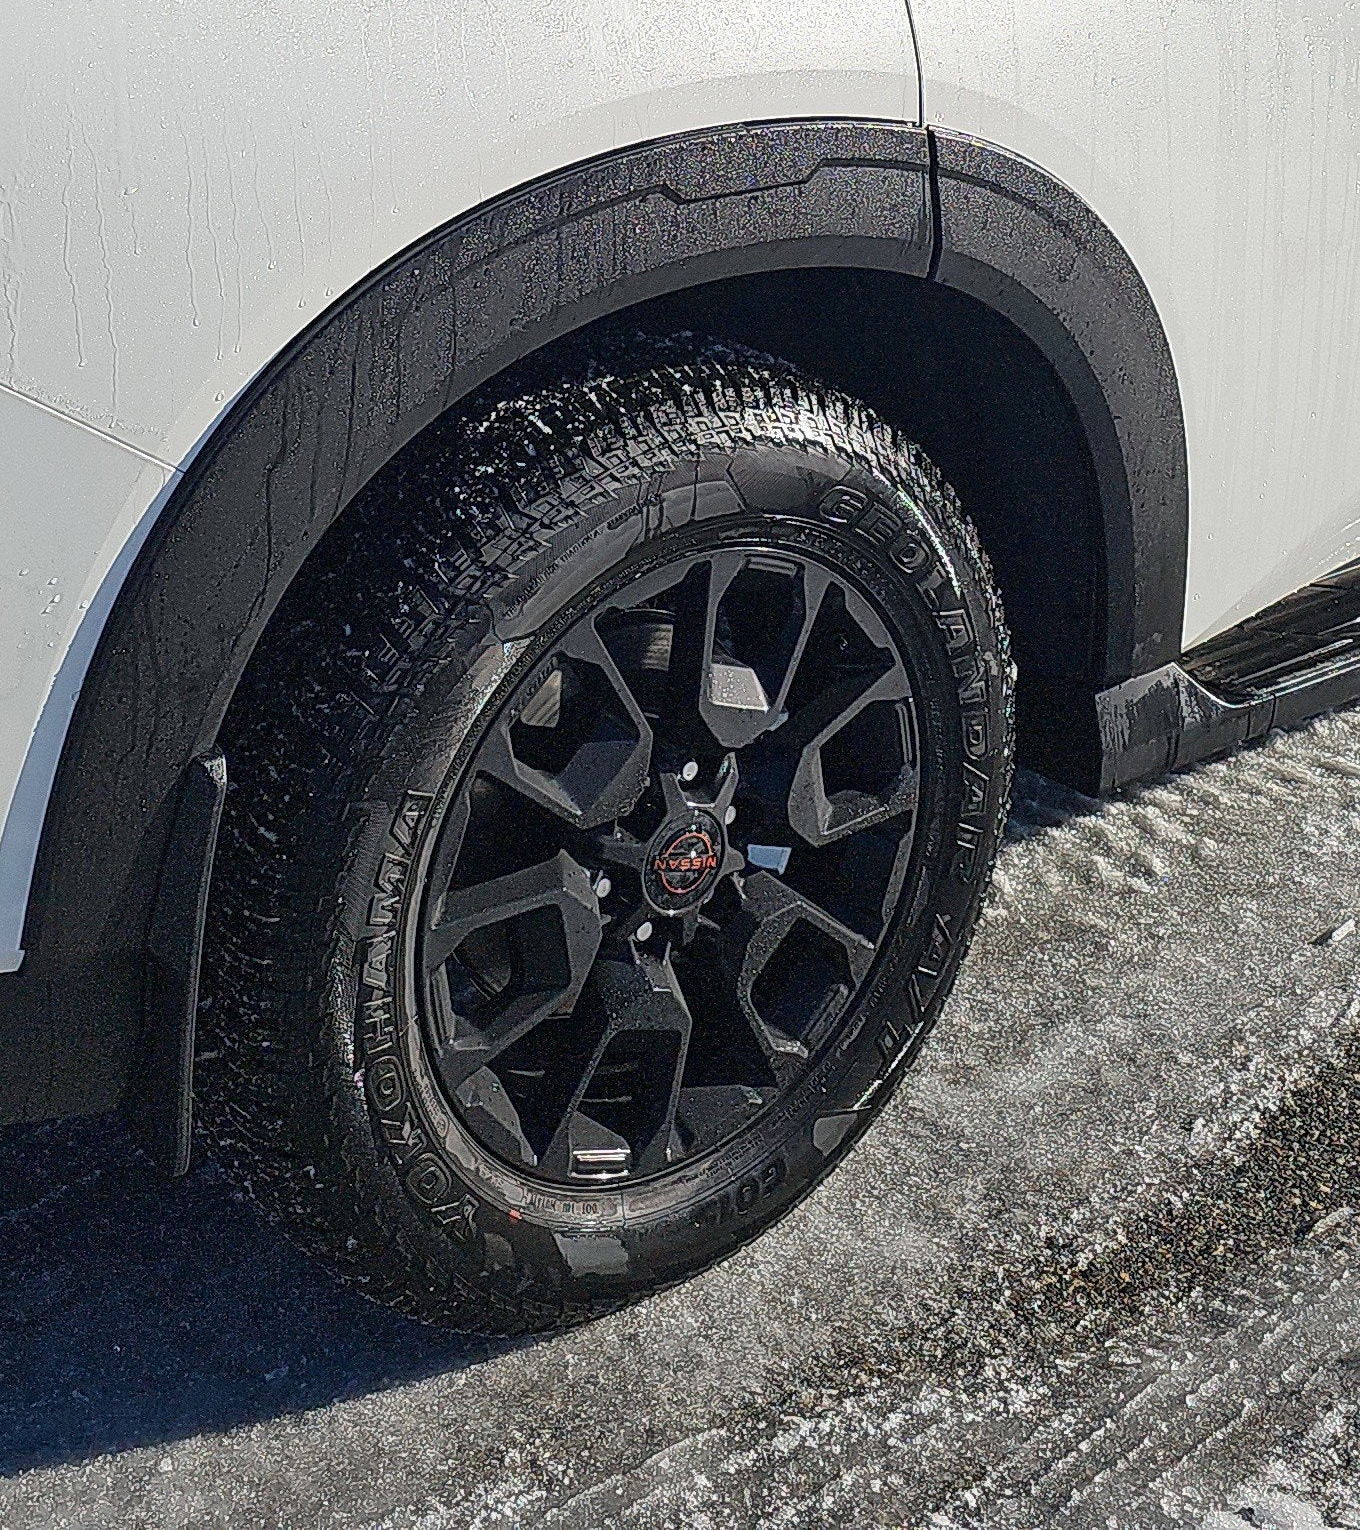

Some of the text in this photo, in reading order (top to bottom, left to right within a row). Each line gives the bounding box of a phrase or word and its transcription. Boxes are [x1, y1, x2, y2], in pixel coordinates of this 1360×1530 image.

[654, 856, 717, 870] NISSAN
[817, 483, 991, 884] GEOLANDAR
[363, 791, 480, 1240] YOKOHAMA
